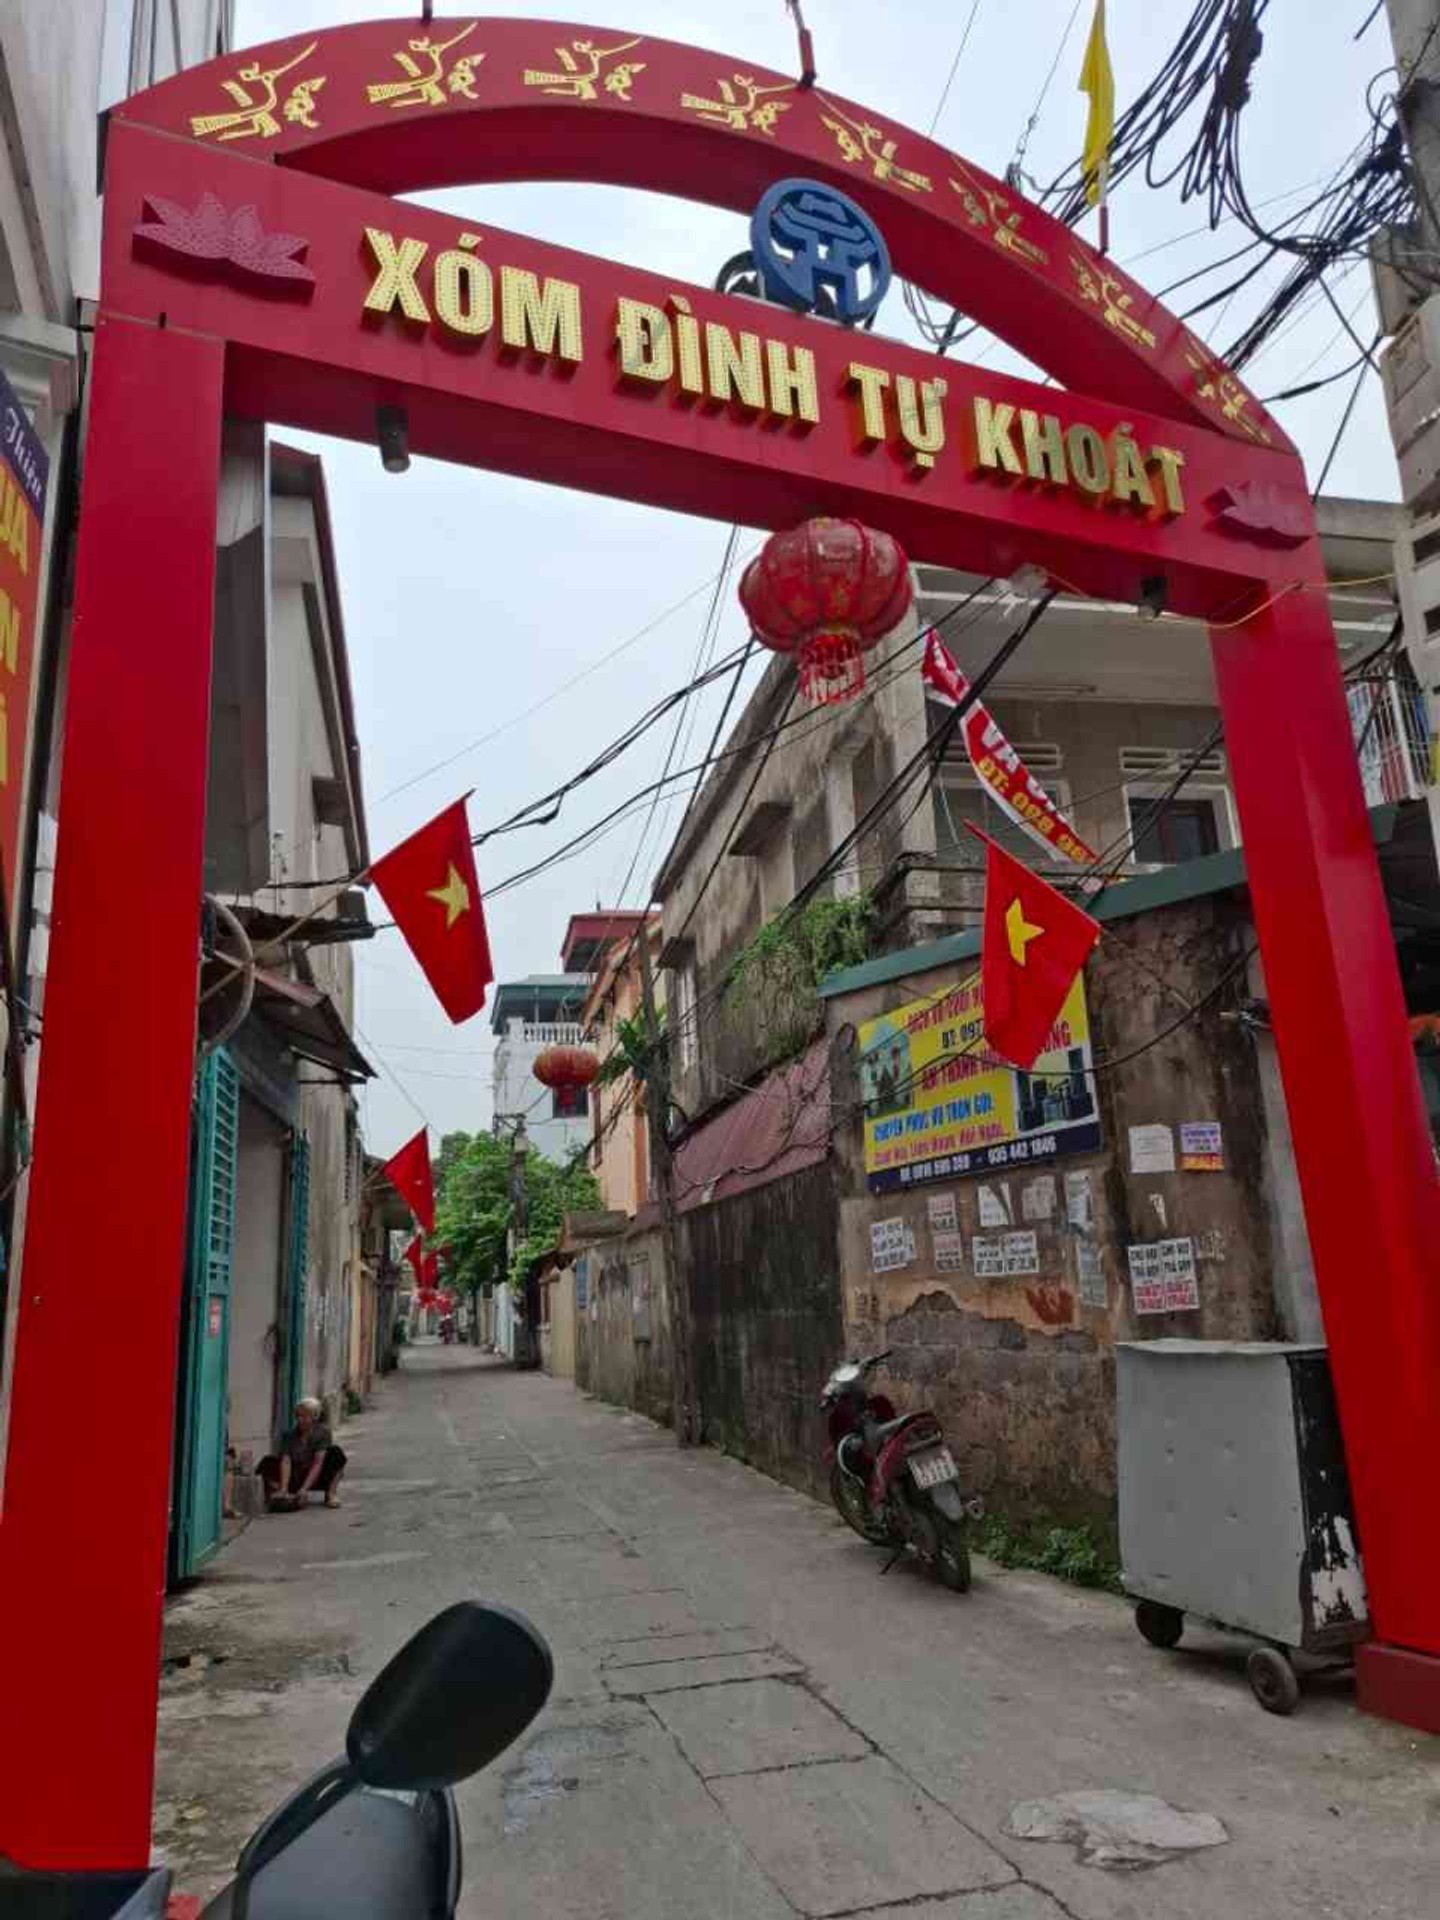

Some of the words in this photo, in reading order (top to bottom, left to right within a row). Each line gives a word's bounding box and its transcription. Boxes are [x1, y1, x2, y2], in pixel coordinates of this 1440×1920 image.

[363, 227, 583, 362] XÓM
[615, 293, 820, 424] ĐÌNH
[847, 361, 948, 469] TỰ
[973, 396, 1187, 514] KHOÁT
